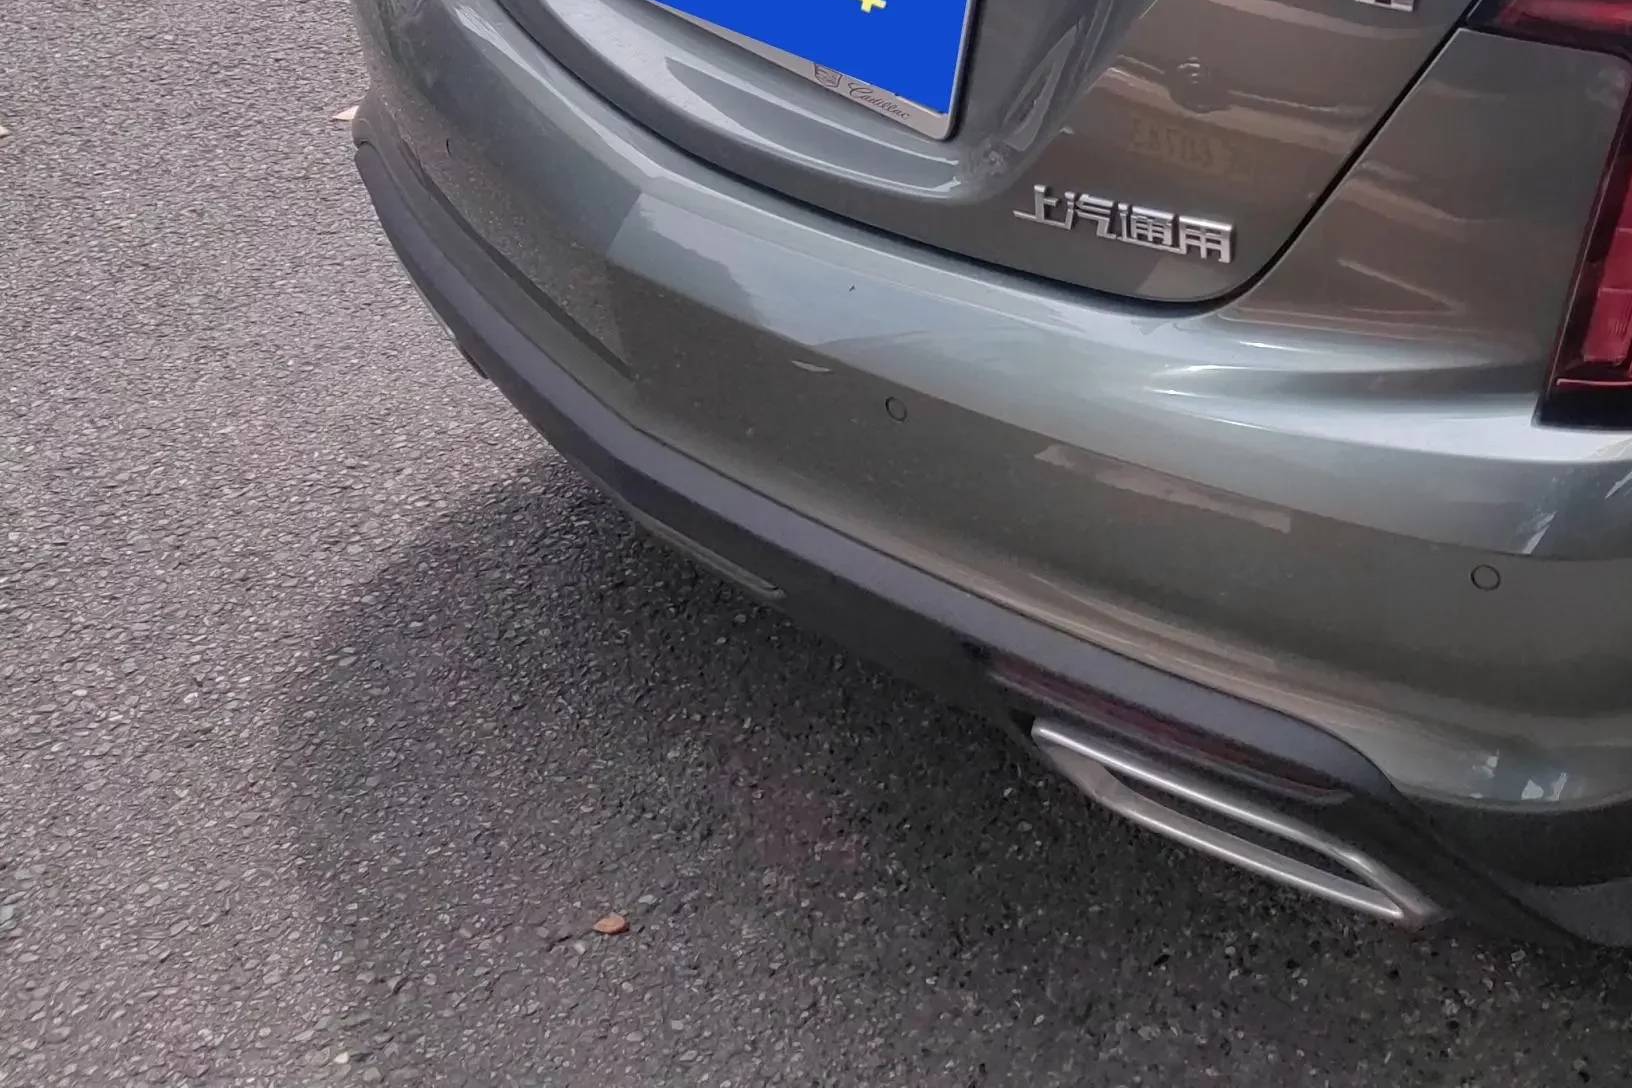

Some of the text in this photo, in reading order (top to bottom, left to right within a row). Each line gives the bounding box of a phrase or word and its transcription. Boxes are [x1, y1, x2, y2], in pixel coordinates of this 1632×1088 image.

[847, 81, 911, 121] Cadillac
[1013, 184, 1234, 263] 上汽通用
